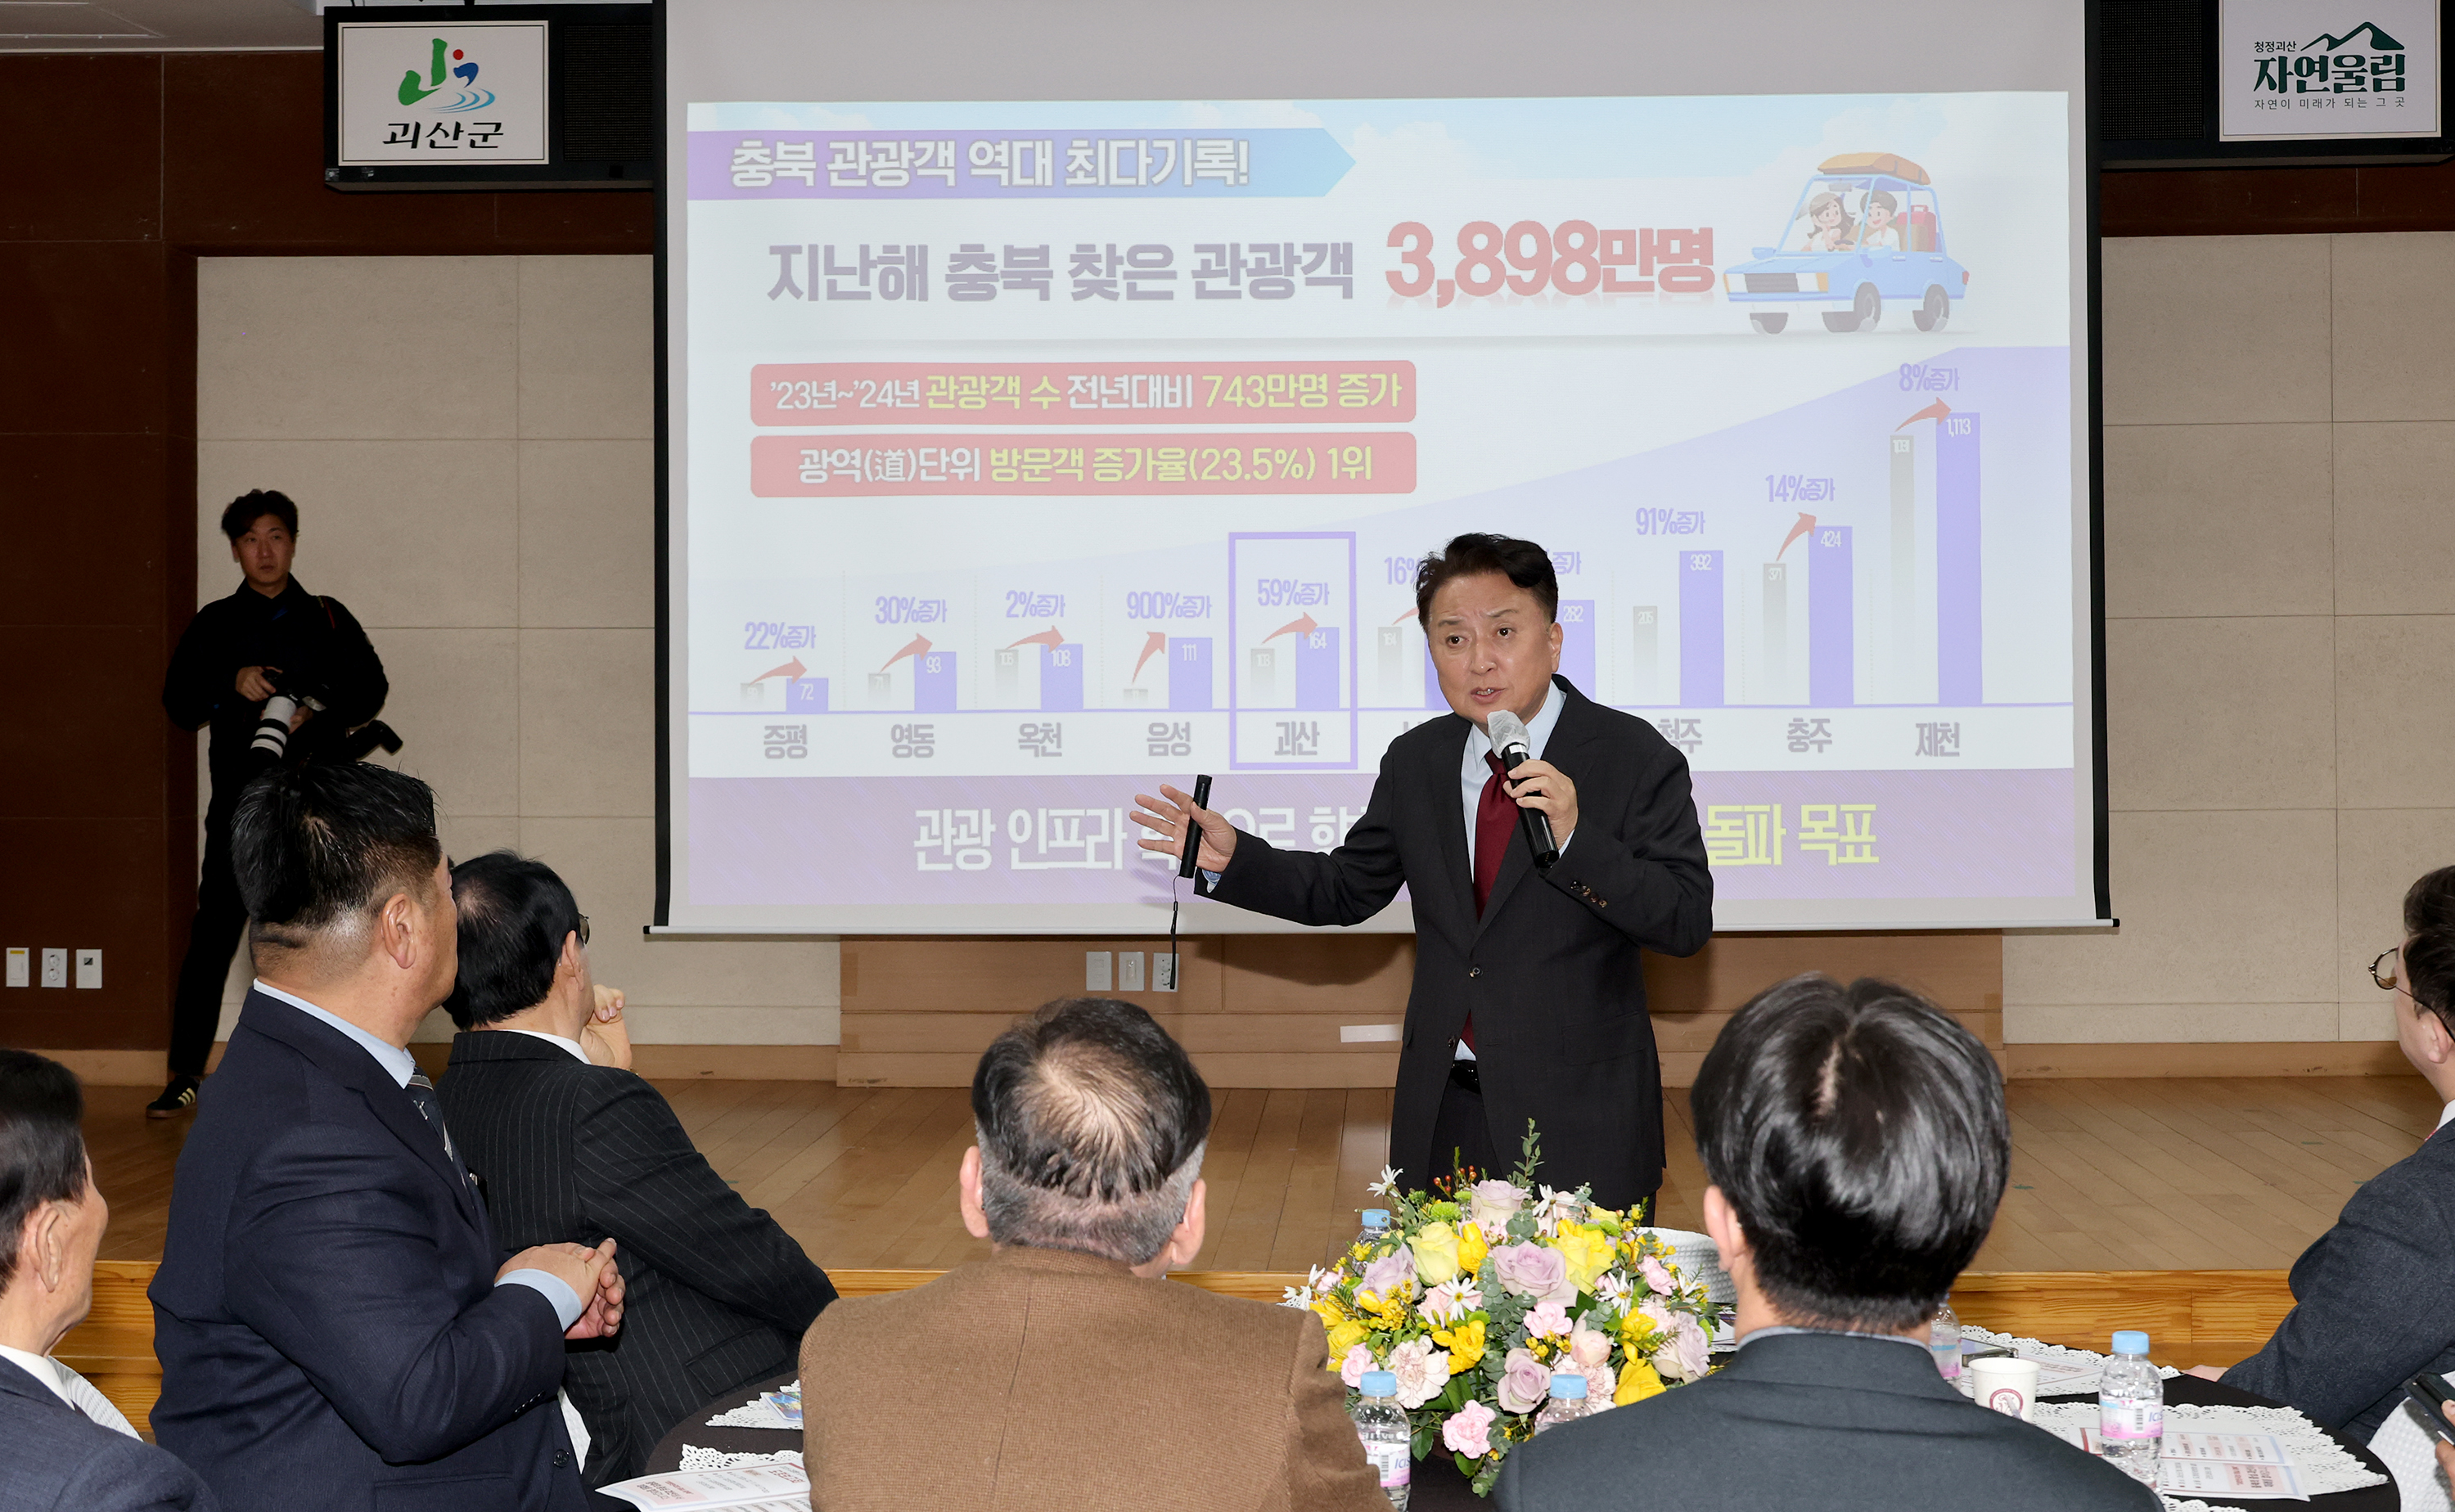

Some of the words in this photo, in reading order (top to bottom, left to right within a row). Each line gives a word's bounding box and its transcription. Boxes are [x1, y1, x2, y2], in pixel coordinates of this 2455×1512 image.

[2254, 40, 2297, 53] 청정괴산
[2253, 54, 2406, 93] 자연울림
[2254, 98, 2291, 110] 자연이
[2300, 97, 2336, 109] 미래가
[2344, 97, 2367, 108] 되는
[2376, 97, 2386, 107] 그
[2395, 97, 2406, 107] 곳
[382, 121, 504, 149] 괴산군
[729, 138, 817, 187] 충북
[827, 139, 956, 187] 관광객
[968, 139, 1054, 187] 역대
[1065, 137, 1250, 187] 최다기록!
[768, 243, 929, 302] 지난해
[944, 243, 1054, 302] 충북
[1068, 243, 1178, 302] 찾은
[1191, 241, 1355, 300] 관광객
[1385, 219, 1716, 309] 3,898만명
[926, 375, 1021, 411] 관광객
[1029, 376, 1061, 411] 수
[1066, 374, 1192, 410] 전년대비
[1201, 373, 1330, 409] 743만명
[1337, 372, 1402, 408] 증가
[798, 447, 981, 484] 광역(道)단위
[989, 446, 1085, 484] 방문객
[1092, 446, 1316, 483] 증가율(23.5%)
[1327, 445, 1374, 481] 1위
[1820, 530, 1842, 548] 424
[1689, 553, 1712, 572] 392
[1006, 589, 1066, 619] 2%증가
[1127, 591, 1212, 620] 900%증가
[1257, 578, 1331, 607] 59%증가
[875, 595, 948, 624] 30%증가
[1562, 605, 1584, 623] 282
[745, 621, 817, 650] 22%증가
[1182, 643, 1197, 661] 111
[926, 655, 942, 674] 93
[800, 683, 814, 701] 72
[764, 723, 809, 759] 증평
[890, 722, 935, 758] 영동
[1017, 722, 1063, 758] 옥천
[1146, 721, 1191, 757] 음성
[1273, 720, 1320, 756] 괴산
[1786, 717, 1833, 754] 충주
[1915, 722, 1961, 758] 제천
[912, 807, 997, 871] 관광
[1007, 807, 1128, 870] 인프라
[1705, 803, 1787, 866] 돌파
[1798, 803, 1880, 866] 목표
